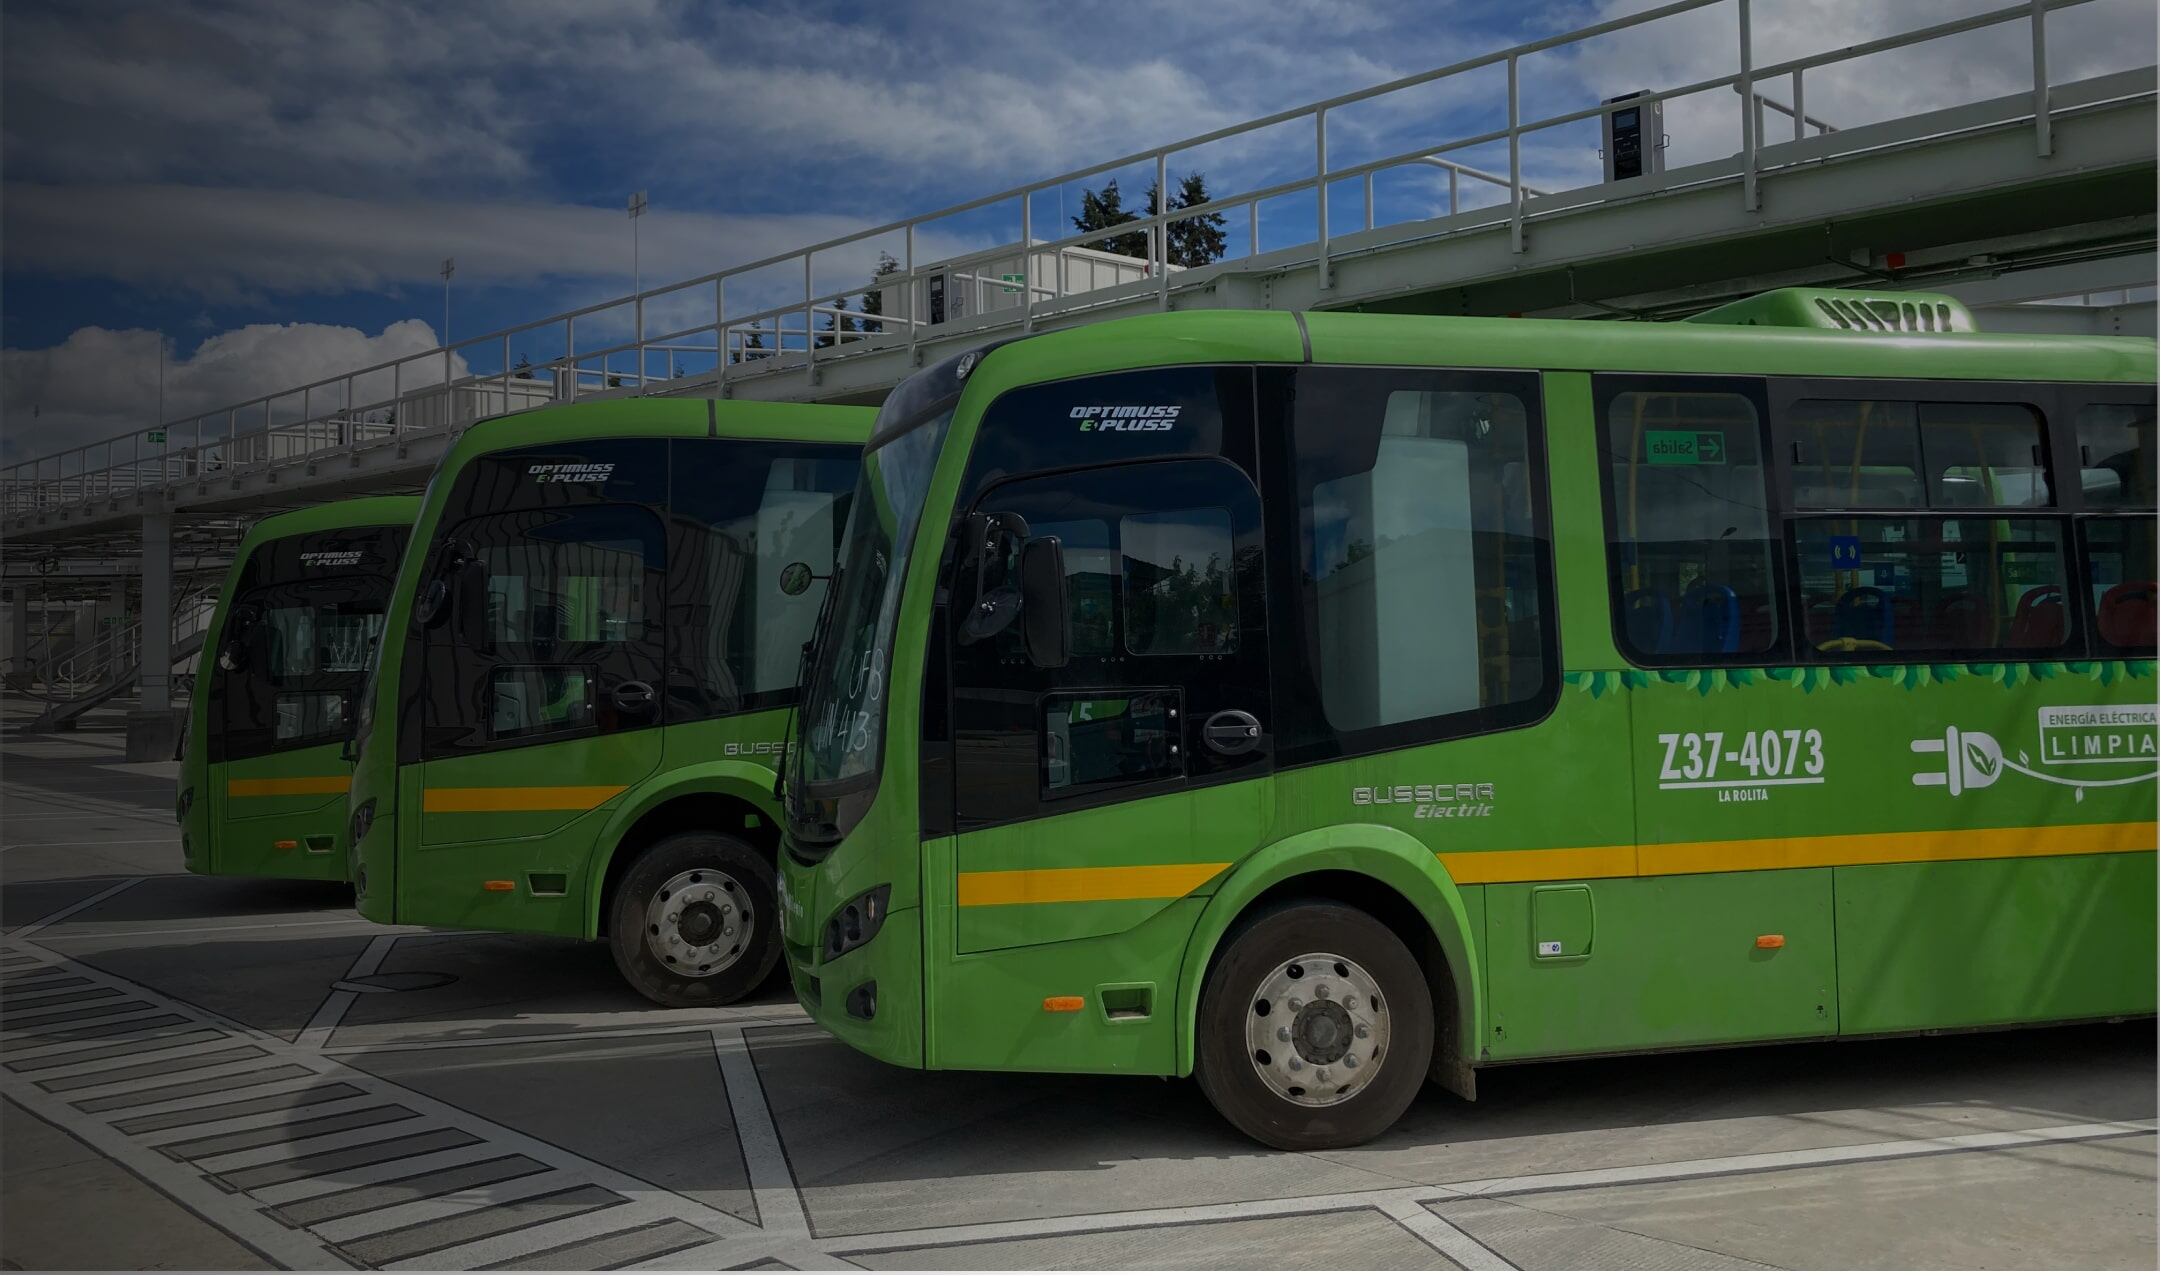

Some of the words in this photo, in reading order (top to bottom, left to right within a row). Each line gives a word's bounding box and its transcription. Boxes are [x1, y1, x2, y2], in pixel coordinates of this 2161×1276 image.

[1070, 406, 1181, 418] OPTIMUSS
[528, 464, 615, 473] OPTIMUSS
[300, 551, 363, 559] OPTIMUSS
[2049, 712, 2097, 725] ENERGÍA
[2100, 711, 2157, 724] ELÉCTRICA
[2052, 734, 2156, 756] LIMPIA
[1658, 729, 1825, 779] Z37-4073
[1353, 783, 1494, 804] BUSSCAR
[1719, 790, 1731, 802] LA
[1733, 788, 1768, 801] ROLITA
[1414, 803, 1494, 818] Electric
